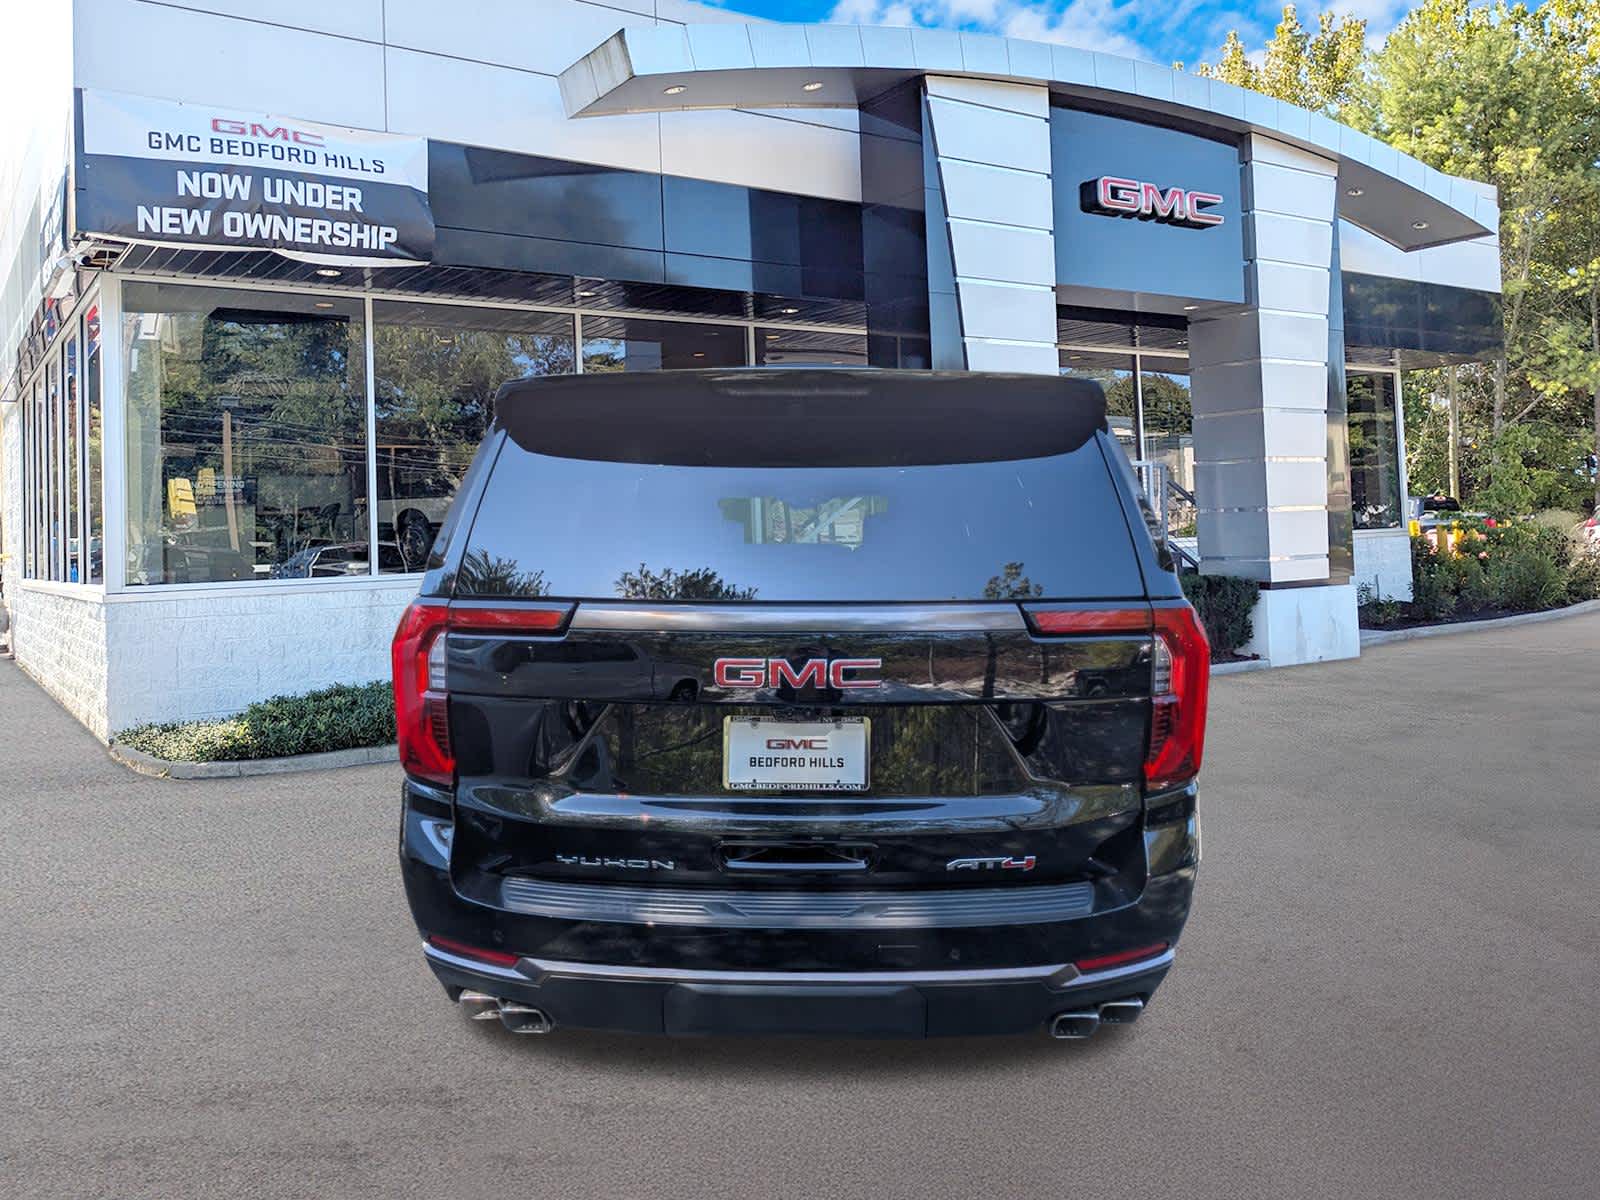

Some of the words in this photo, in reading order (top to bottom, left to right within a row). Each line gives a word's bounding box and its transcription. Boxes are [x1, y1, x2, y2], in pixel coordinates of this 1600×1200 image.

[210, 117, 326, 148] GMC
[147, 131, 201, 153] GMC
[210, 138, 317, 166] BEDFORD
[324, 153, 385, 174] HILLS
[177, 170, 252, 201] NOW
[263, 177, 363, 213] UNDER
[1096, 175, 1225, 225] GMC
[137, 205, 211, 236] NEW
[223, 211, 398, 250] OWNERSHIP
[714, 657, 882, 688] GMC
[766, 738, 829, 750] GMC
[750, 756, 806, 768] BEDFORD
[809, 757, 845, 768] HILLS
[556, 855, 675, 870] YUKON
[946, 855, 1036, 871] AT4
